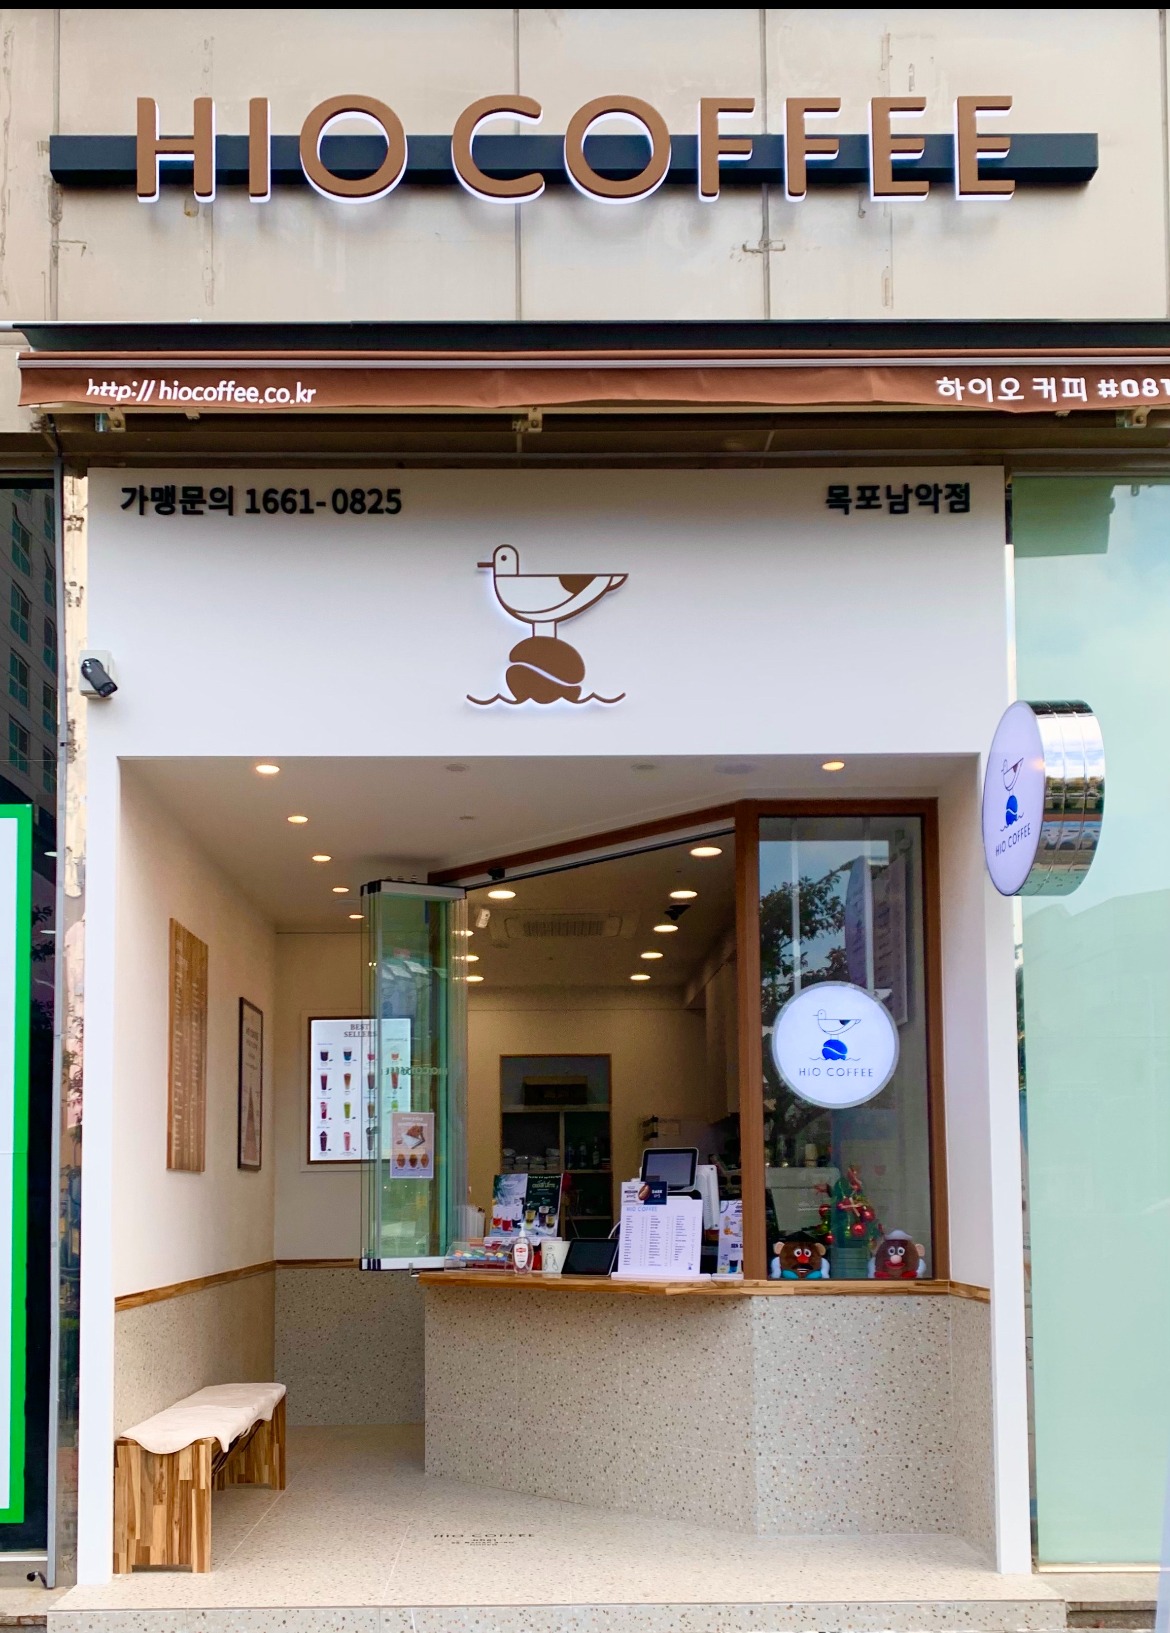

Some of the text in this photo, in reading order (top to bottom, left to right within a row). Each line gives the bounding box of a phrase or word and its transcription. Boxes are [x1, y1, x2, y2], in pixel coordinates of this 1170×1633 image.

[137, 94, 1015, 203] HIO COFFEE
[936, 376, 1024, 403] 하이오
[1032, 377, 1088, 403] 커피
[120, 484, 234, 516] 가맹문의
[825, 482, 970, 515] 목포남악점
[995, 823, 1031, 857] HIO COFFEE
[798, 1067, 874, 1078] HIO COFFEE
